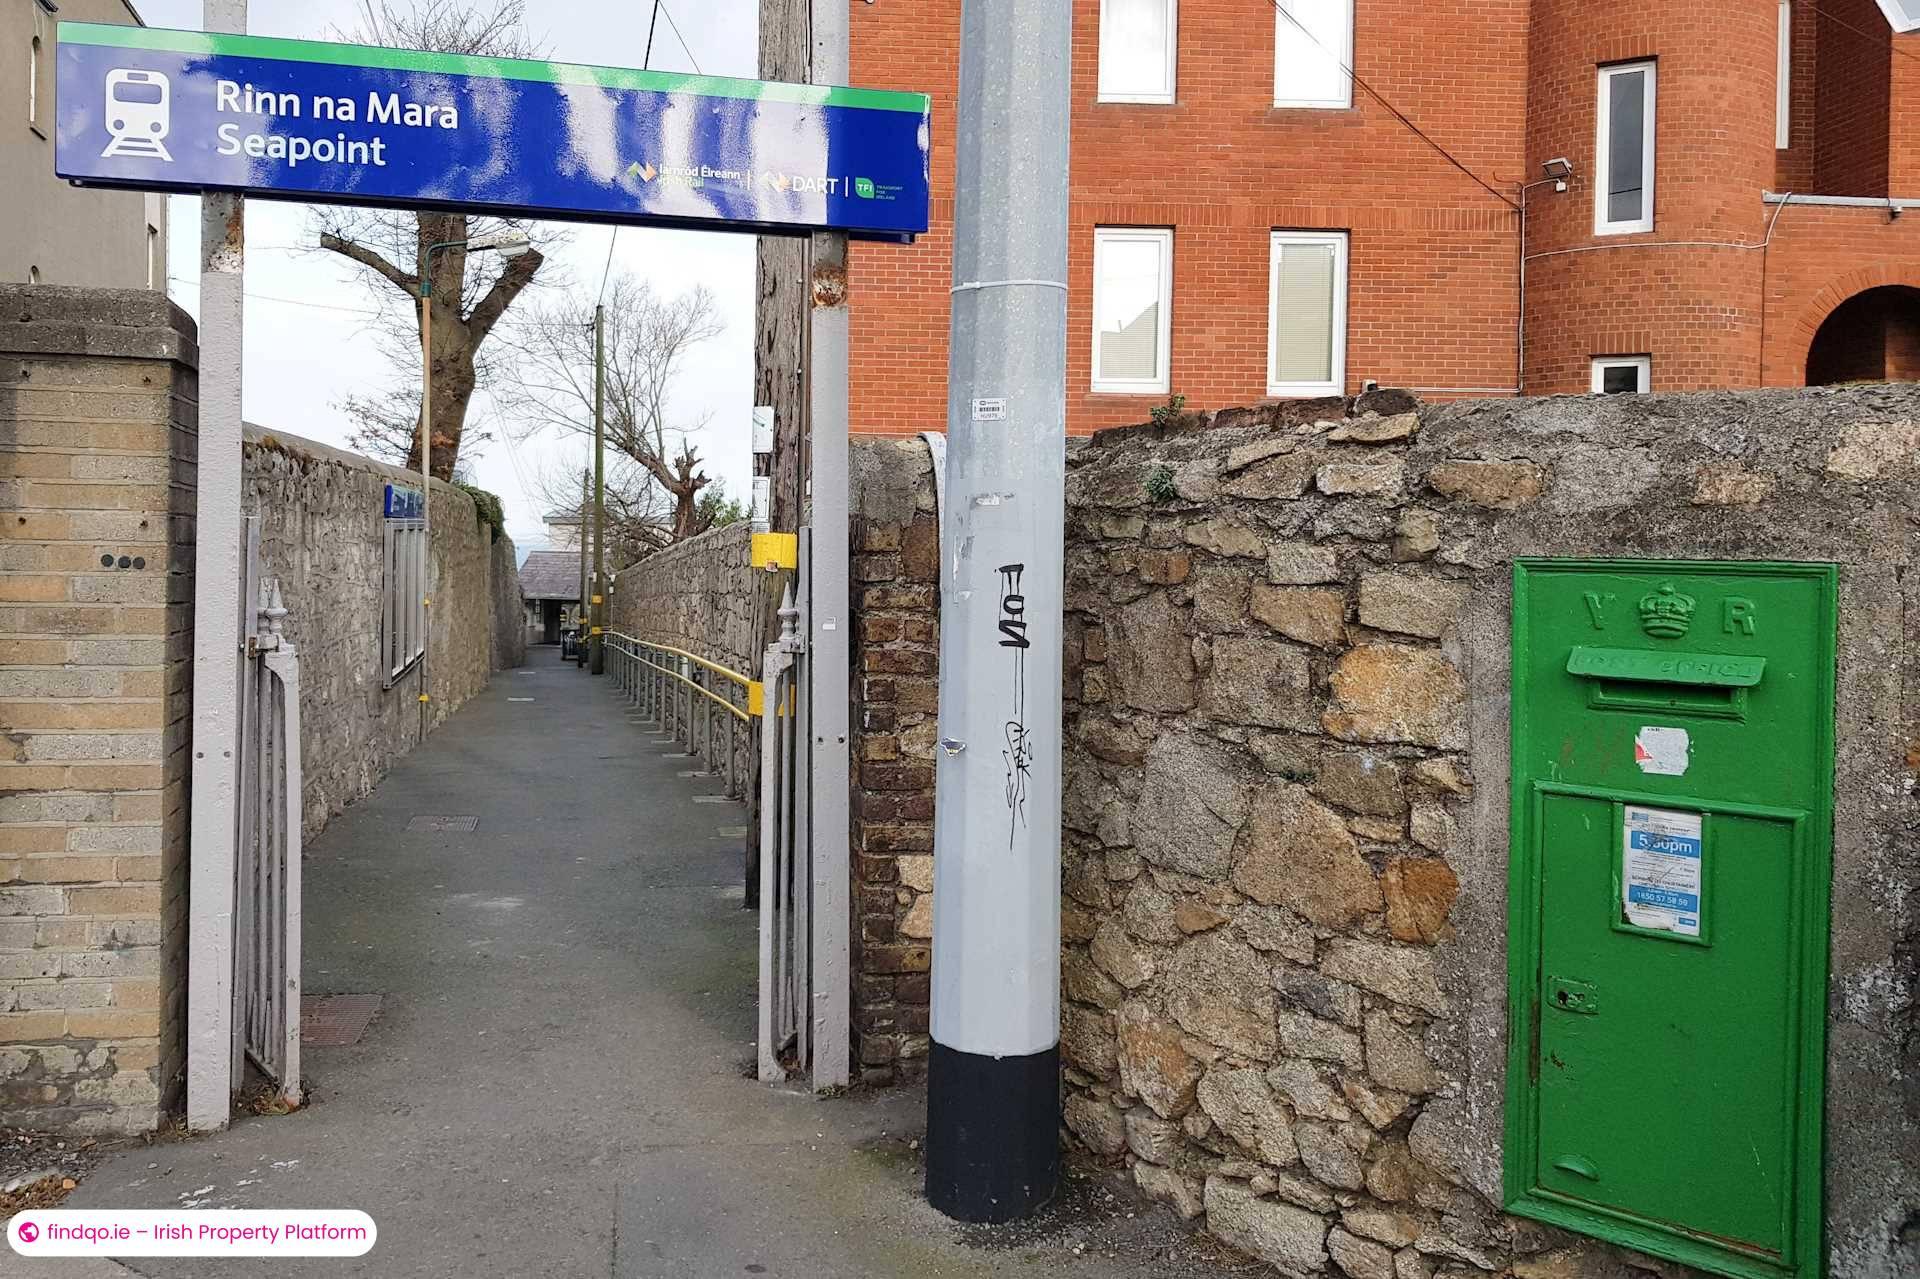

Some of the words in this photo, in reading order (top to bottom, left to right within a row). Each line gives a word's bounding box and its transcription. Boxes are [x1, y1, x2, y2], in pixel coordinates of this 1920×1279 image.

[216, 79, 300, 115] Rinn
[313, 94, 357, 122] na
[366, 91, 459, 129] Mara
[216, 122, 387, 167] Seapoint
[792, 176, 839, 194] DART
[857, 183, 873, 193] TFI
[1584, 591, 1617, 630] V
[1723, 595, 1757, 636] R
